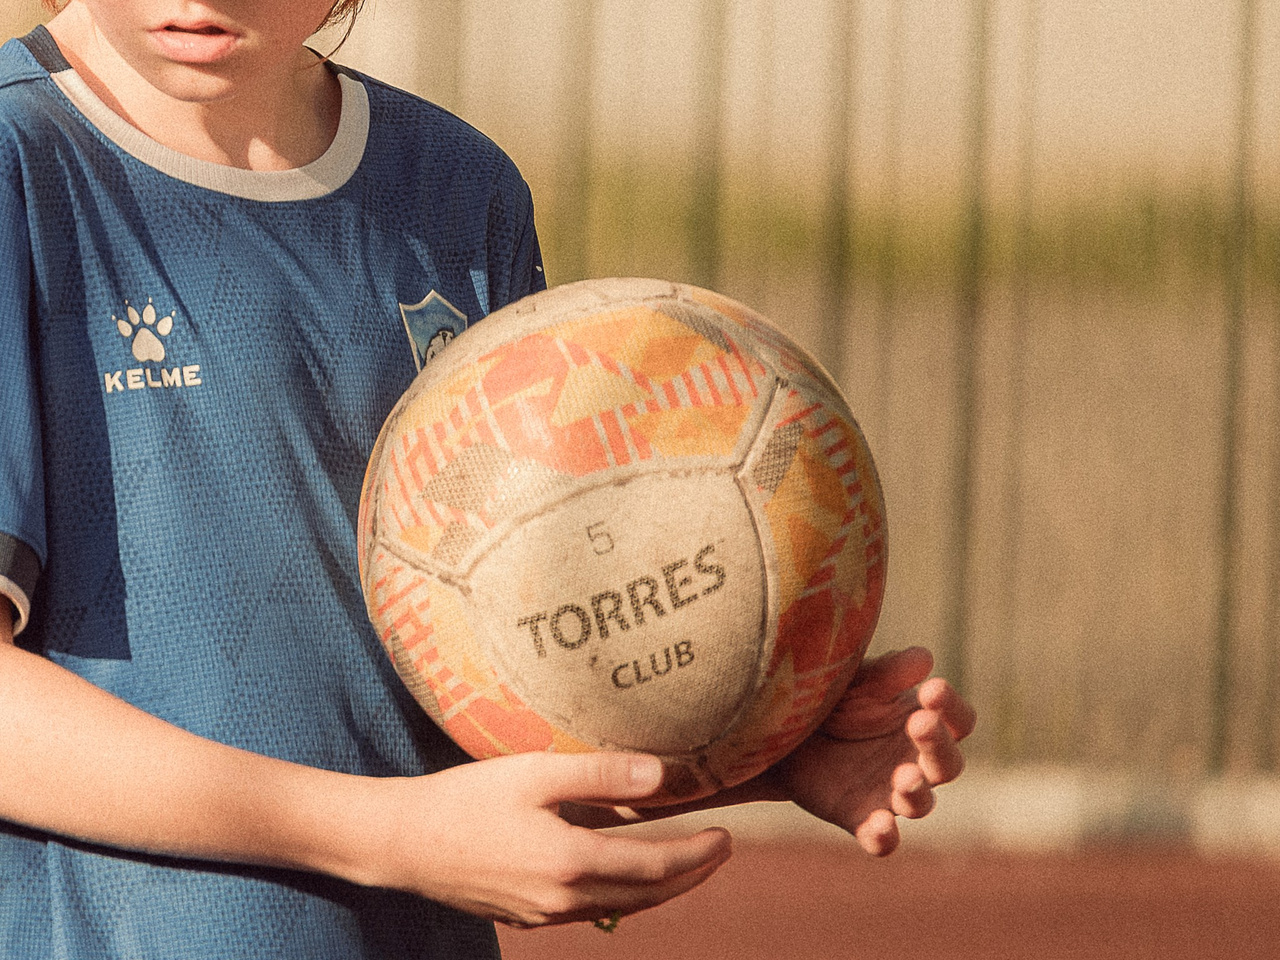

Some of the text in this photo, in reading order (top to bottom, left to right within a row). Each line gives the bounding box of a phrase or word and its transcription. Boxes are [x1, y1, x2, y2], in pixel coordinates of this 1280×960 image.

[104, 364, 202, 393] KELME
[586, 521, 614, 556] 5
[517, 544, 726, 659] TORRES
[611, 640, 695, 689] CLUB
